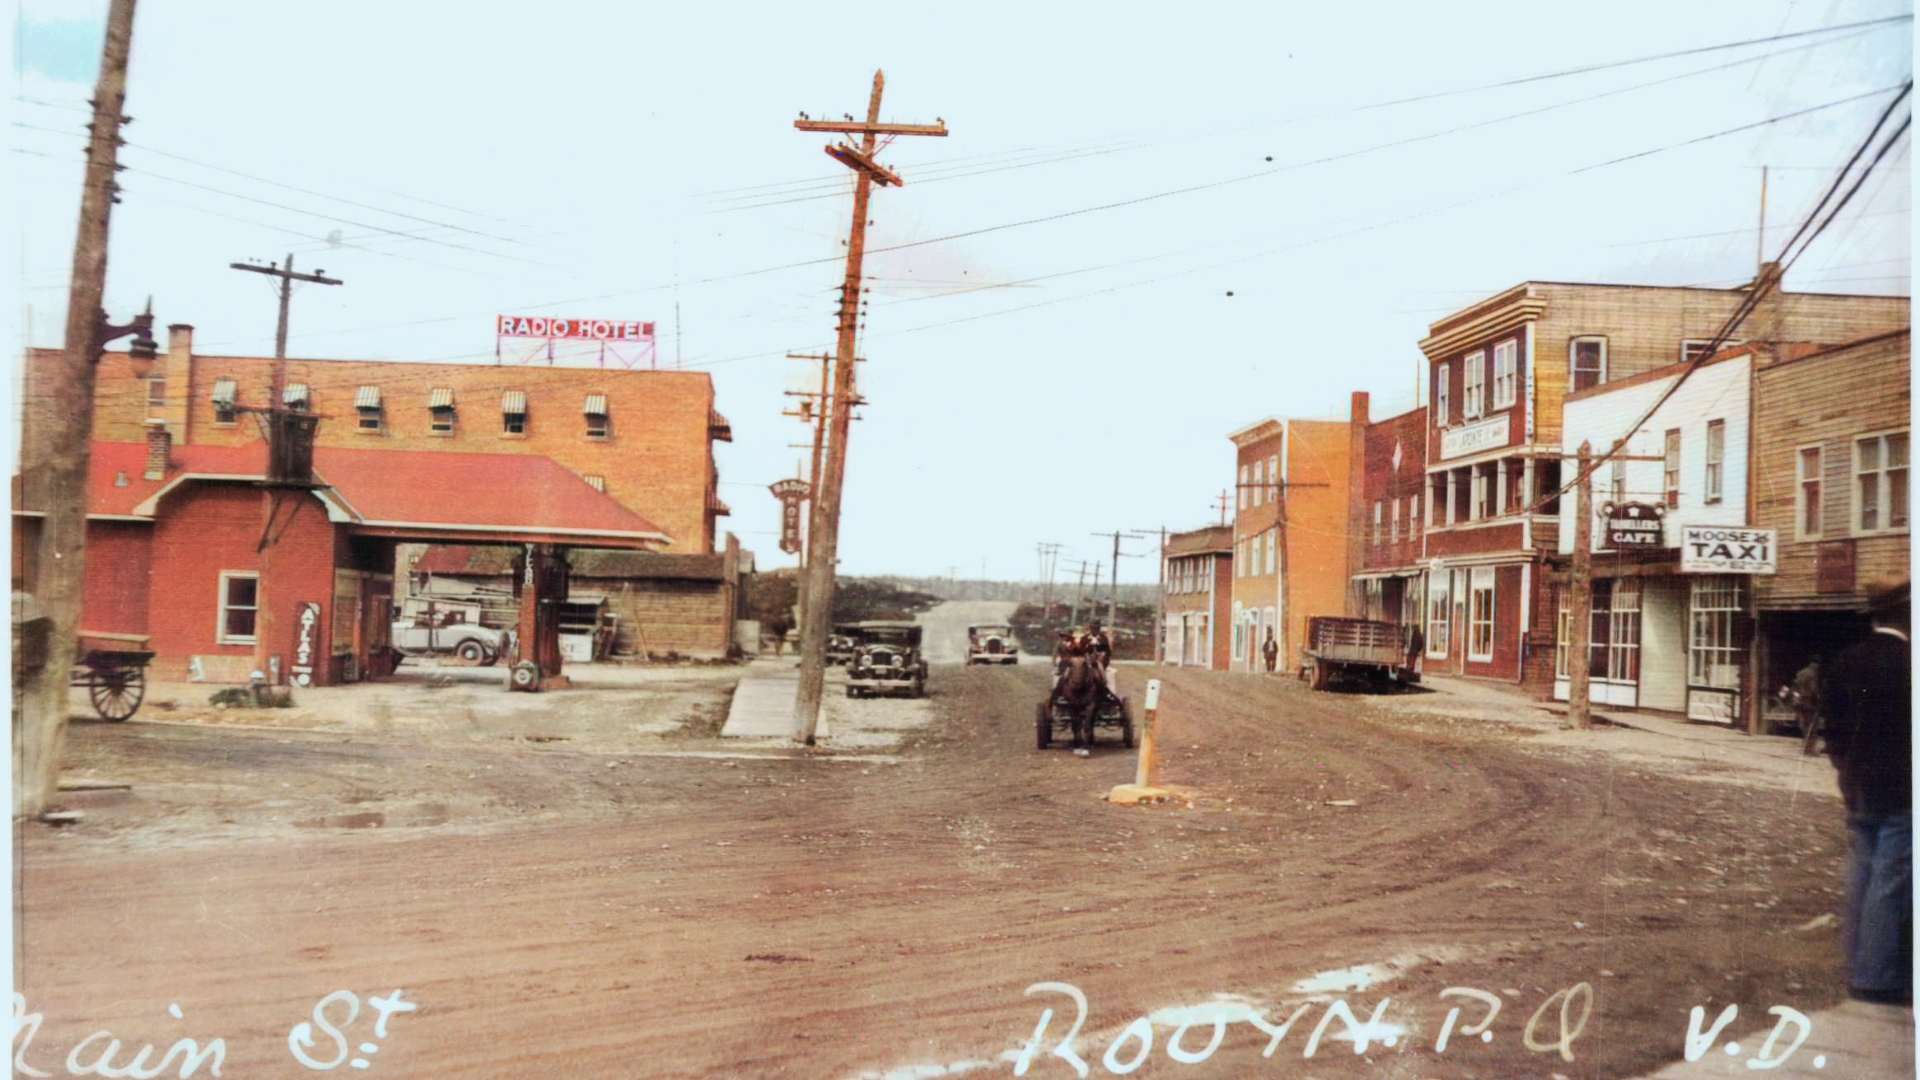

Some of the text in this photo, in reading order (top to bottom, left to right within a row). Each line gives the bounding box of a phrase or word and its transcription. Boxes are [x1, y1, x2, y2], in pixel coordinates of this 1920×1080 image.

[501, 317, 649, 341] RADIO HOTEL
[773, 480, 811, 495] RADIO
[785, 496, 797, 553] HOTEL
[1612, 532, 1656, 544] CAFE
[1688, 530, 1751, 543] MOOSE
[1689, 542, 1768, 561] TAXI
[296, 607, 315, 665] ATLAS
